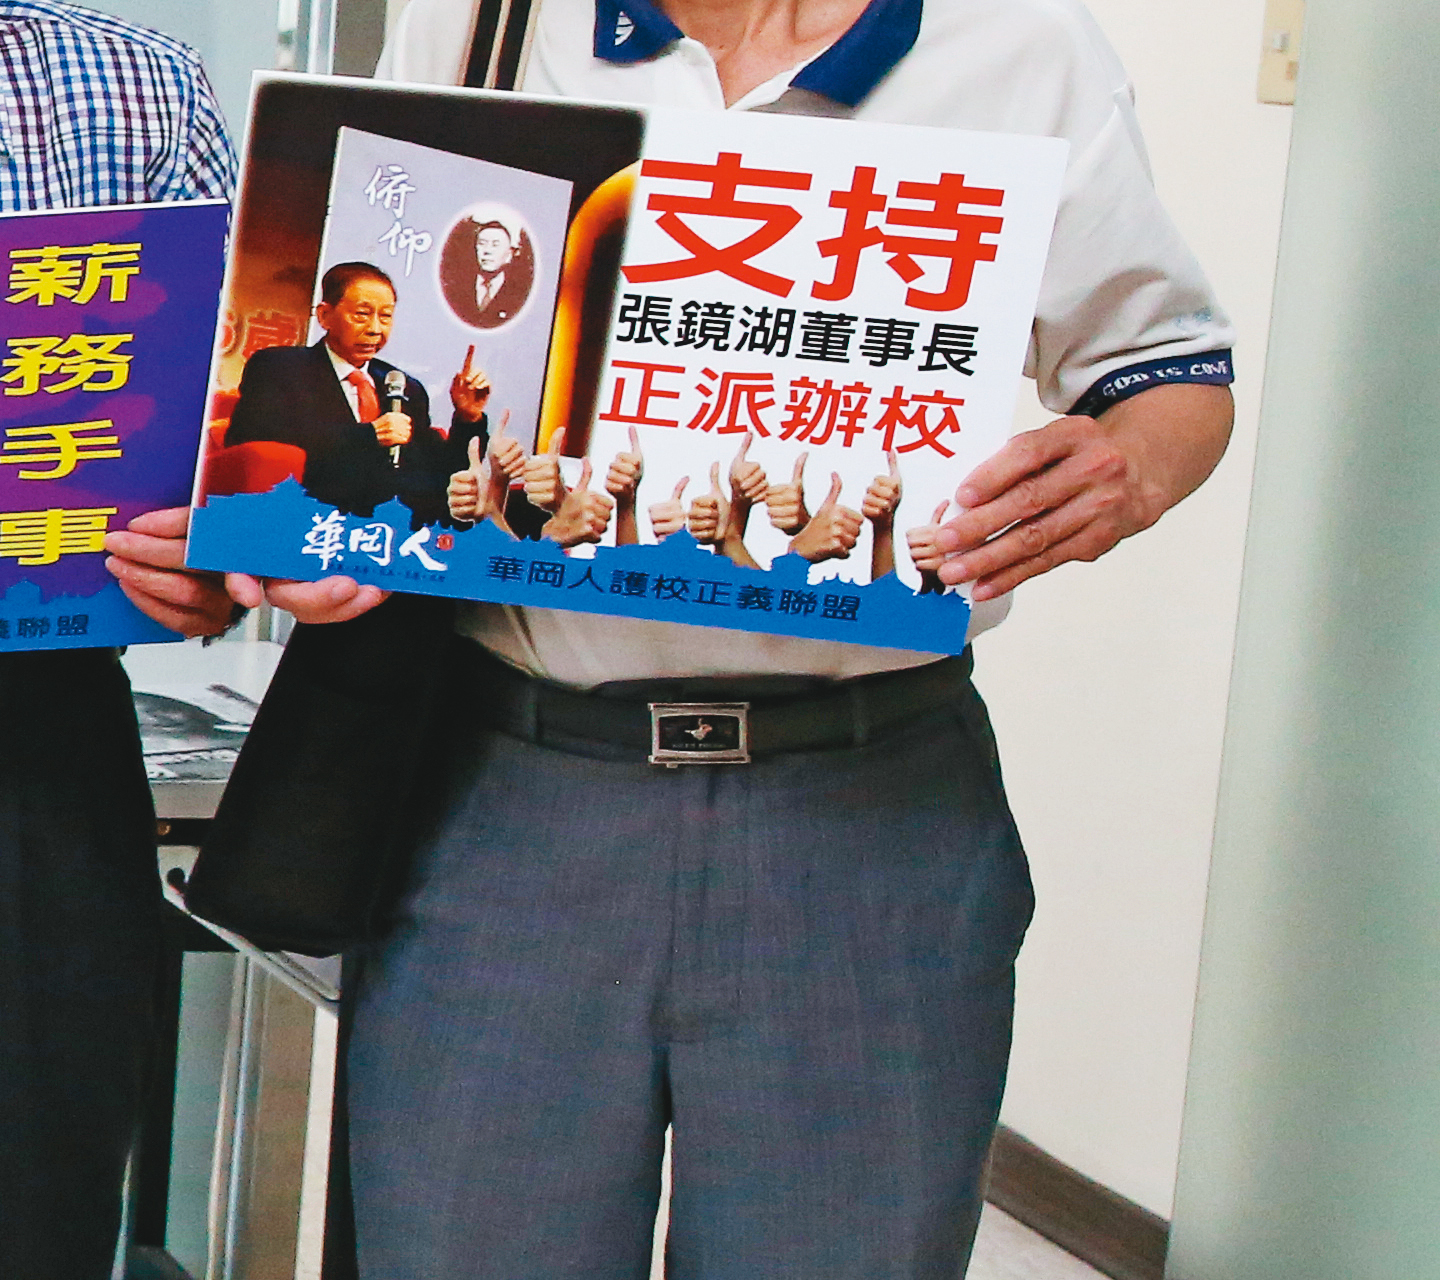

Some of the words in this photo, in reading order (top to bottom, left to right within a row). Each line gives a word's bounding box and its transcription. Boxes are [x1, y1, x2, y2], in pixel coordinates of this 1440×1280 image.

[619, 151, 1005, 312] 支持
[615, 292, 979, 377] 張鏡湖董事長
[597, 356, 965, 460] 正派辦校
[301, 510, 448, 571] 華岡人
[487, 555, 860, 622] 華岡人護校正義聯盟
